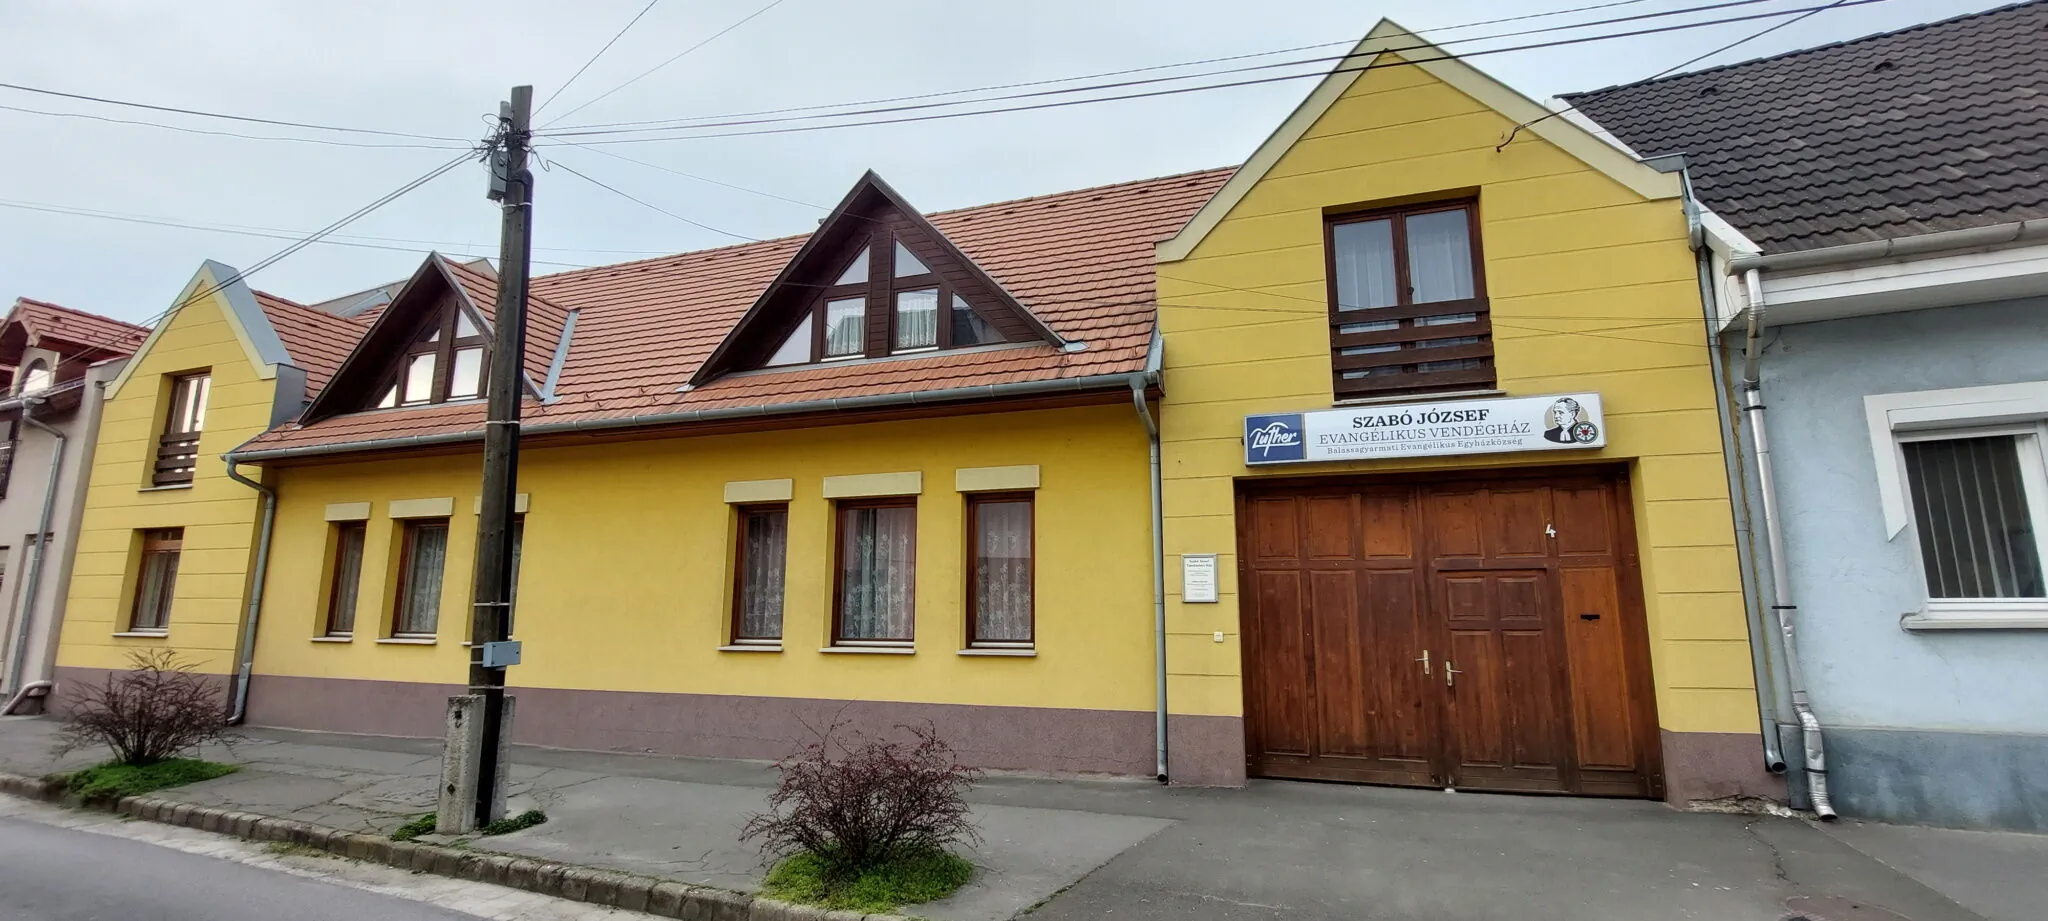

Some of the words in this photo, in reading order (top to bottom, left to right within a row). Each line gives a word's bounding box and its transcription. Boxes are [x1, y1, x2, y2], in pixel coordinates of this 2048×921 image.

[1353, 410, 1413, 428] SZABÓ
[1417, 408, 1490, 424] JÓZSEF
[1251, 423, 1300, 457] Luther
[1319, 429, 1426, 445] EVANGÉLIKUS
[1429, 420, 1531, 438] VENDÉGHÁZ
[1327, 444, 1399, 455] Balassagyarmati
[1401, 441, 1456, 451] Evangélikus
[1457, 438, 1523, 449] Egyházközség
[1545, 524, 1556, 538] 4
